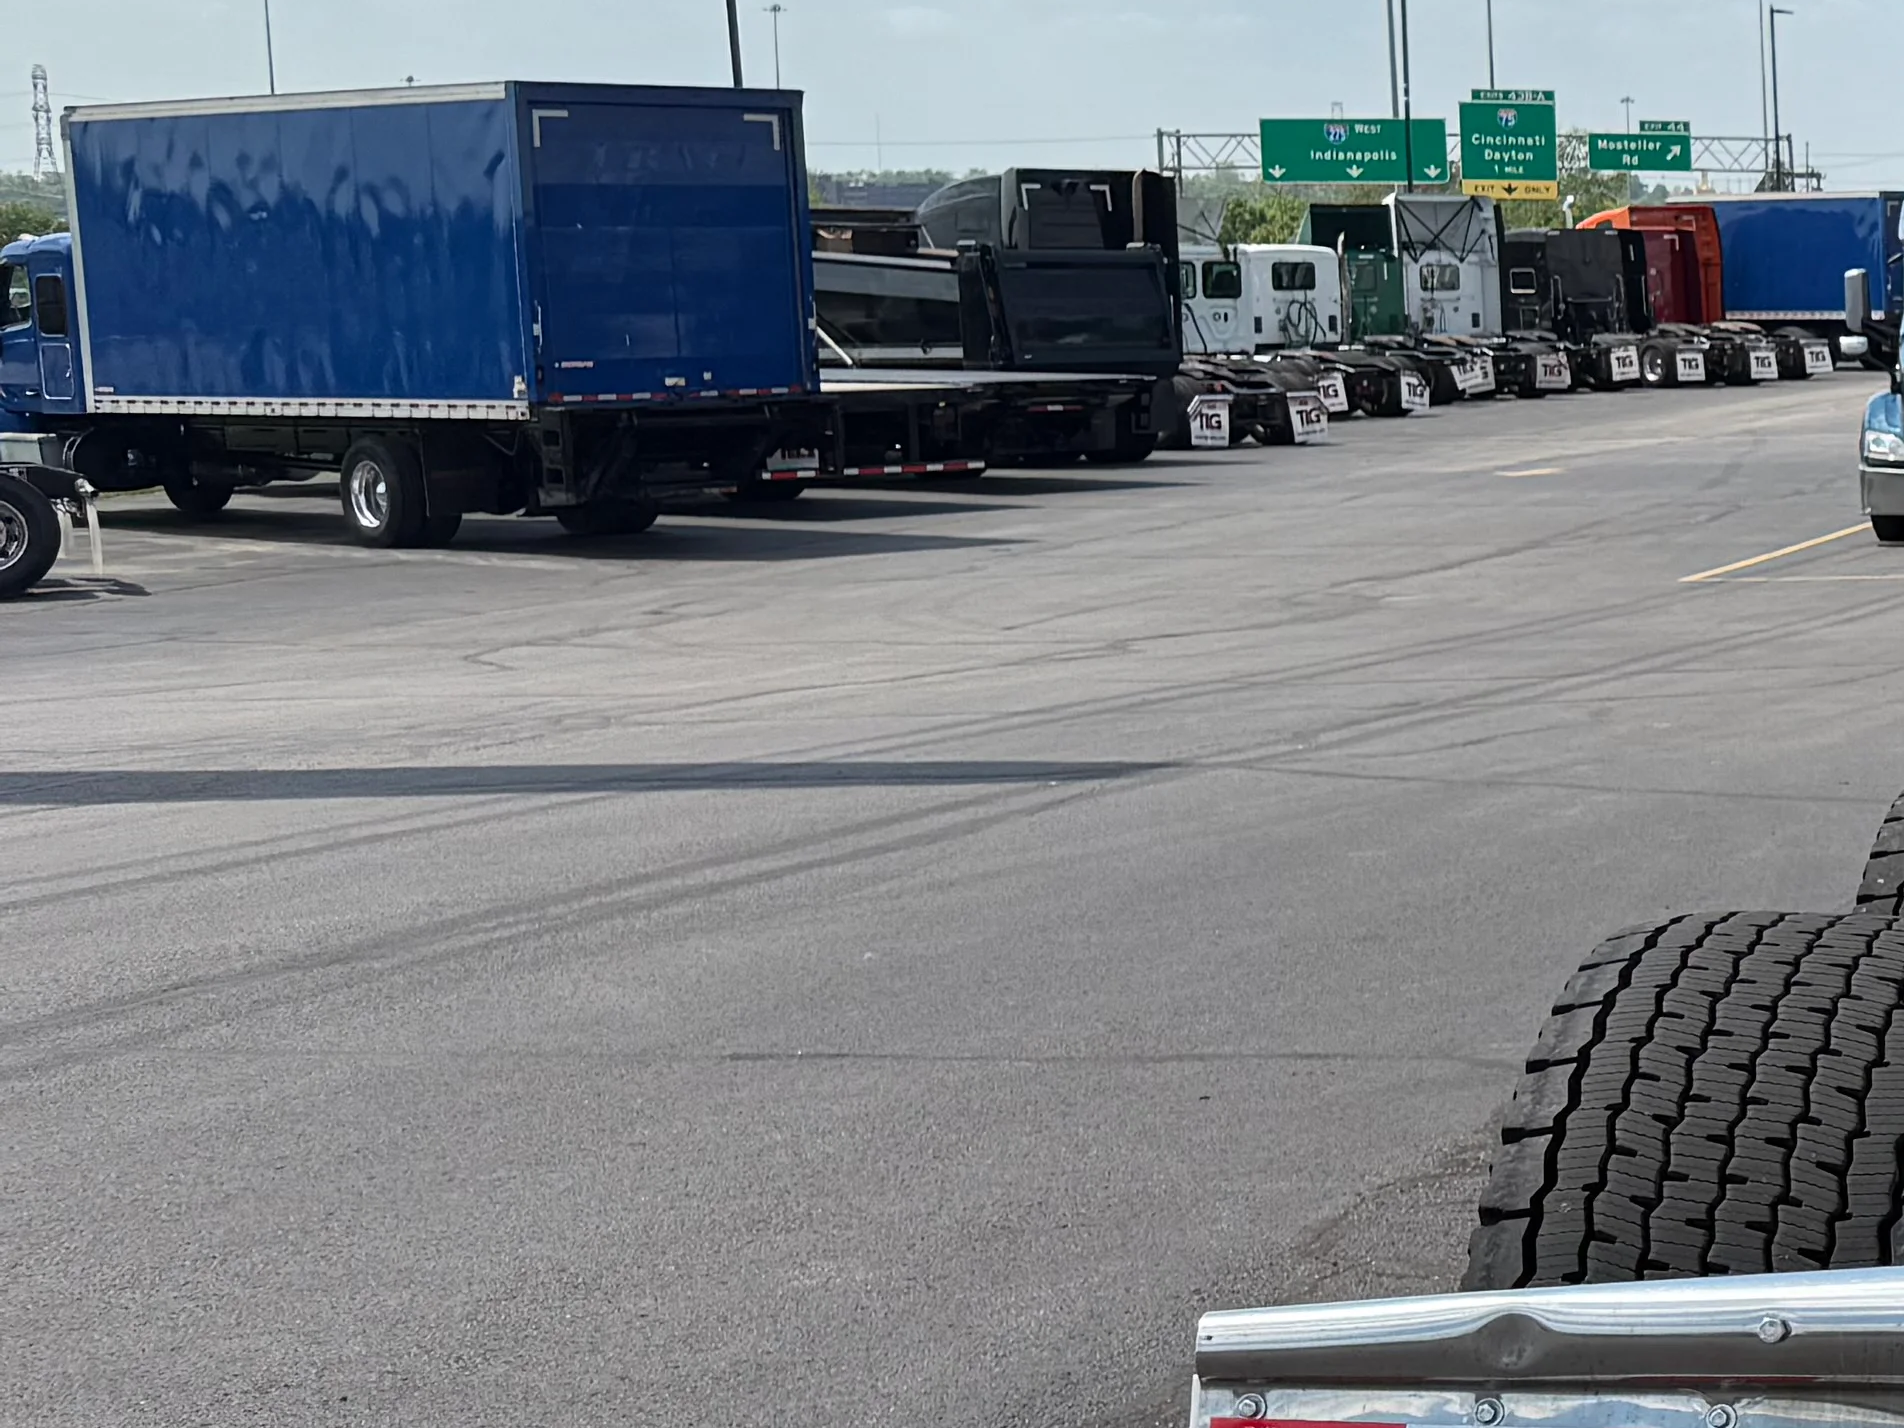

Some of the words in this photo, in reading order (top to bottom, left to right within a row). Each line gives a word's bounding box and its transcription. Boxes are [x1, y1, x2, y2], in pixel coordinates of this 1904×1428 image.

[1501, 113, 1516, 127] 75
[1354, 123, 1381, 134] WEST
[1667, 122, 1685, 132] 44
[1471, 133, 1546, 147] Cincinnati
[1597, 138, 1662, 151] Mosteller
[1310, 149, 1397, 163] Indianapolis
[1484, 149, 1534, 163] Dayton
[1622, 153, 1639, 166] Rd
[1504, 165, 1525, 175] MILE
[1474, 184, 1495, 194] EXIT
[1524, 185, 1551, 195] ONLY
